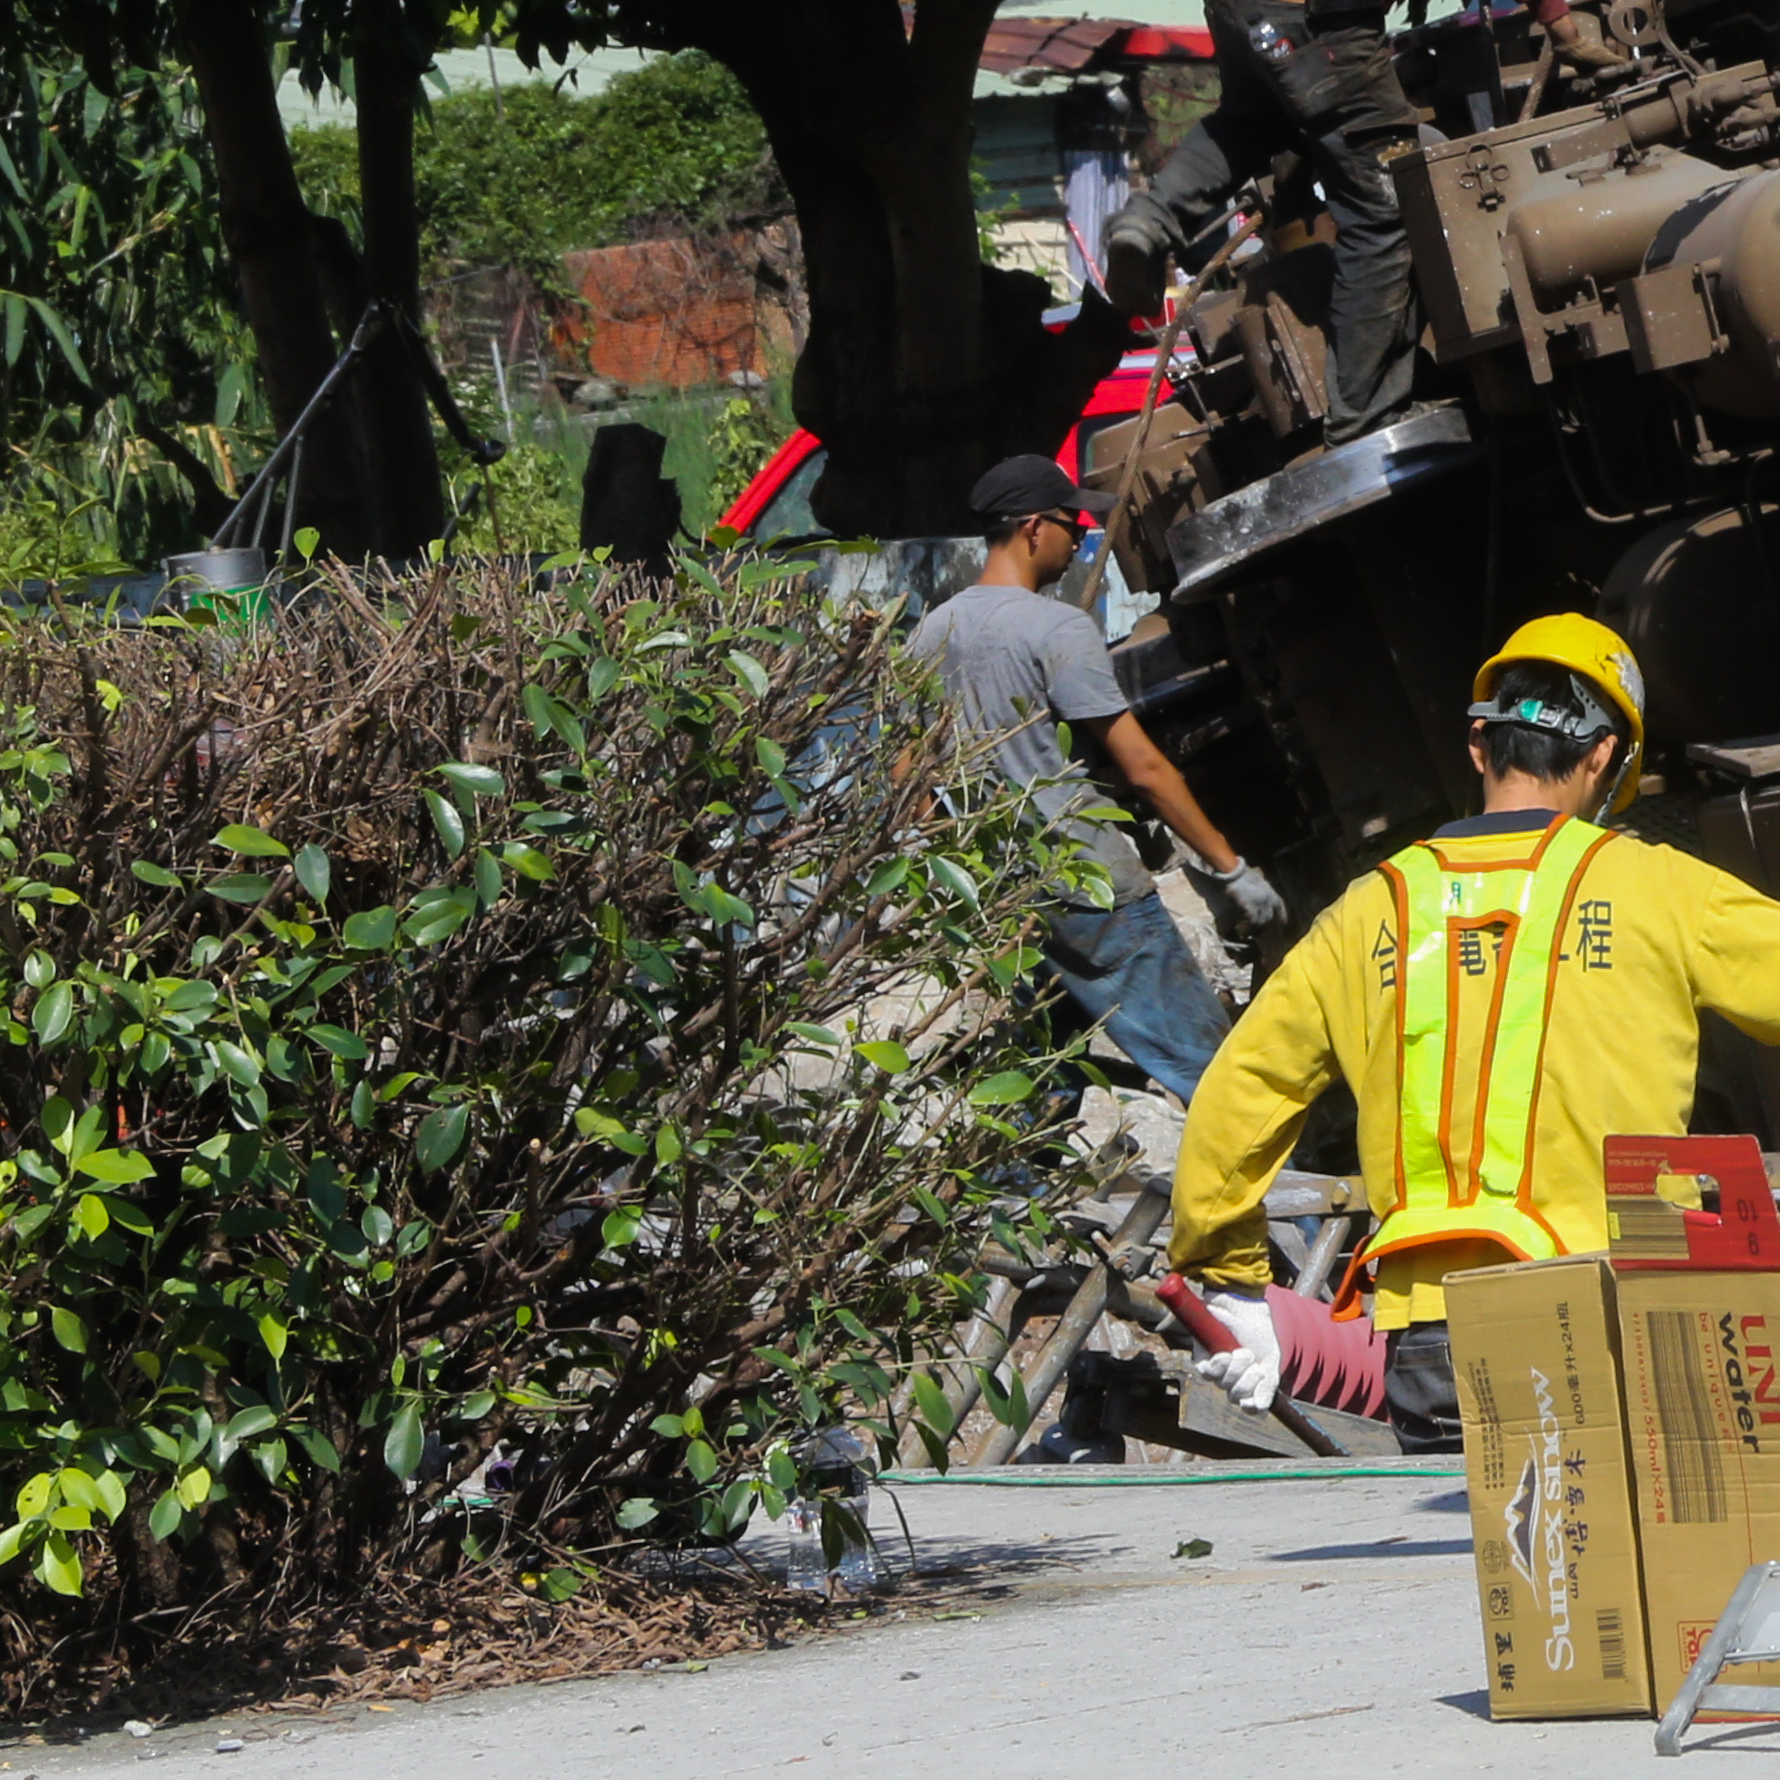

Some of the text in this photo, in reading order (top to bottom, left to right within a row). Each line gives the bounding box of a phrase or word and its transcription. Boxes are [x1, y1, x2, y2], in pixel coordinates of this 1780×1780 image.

[1699, 1312, 1727, 1421] be unique
[1719, 1312, 1760, 1453] water
[1530, 1366, 1575, 1671] Sunex snow
